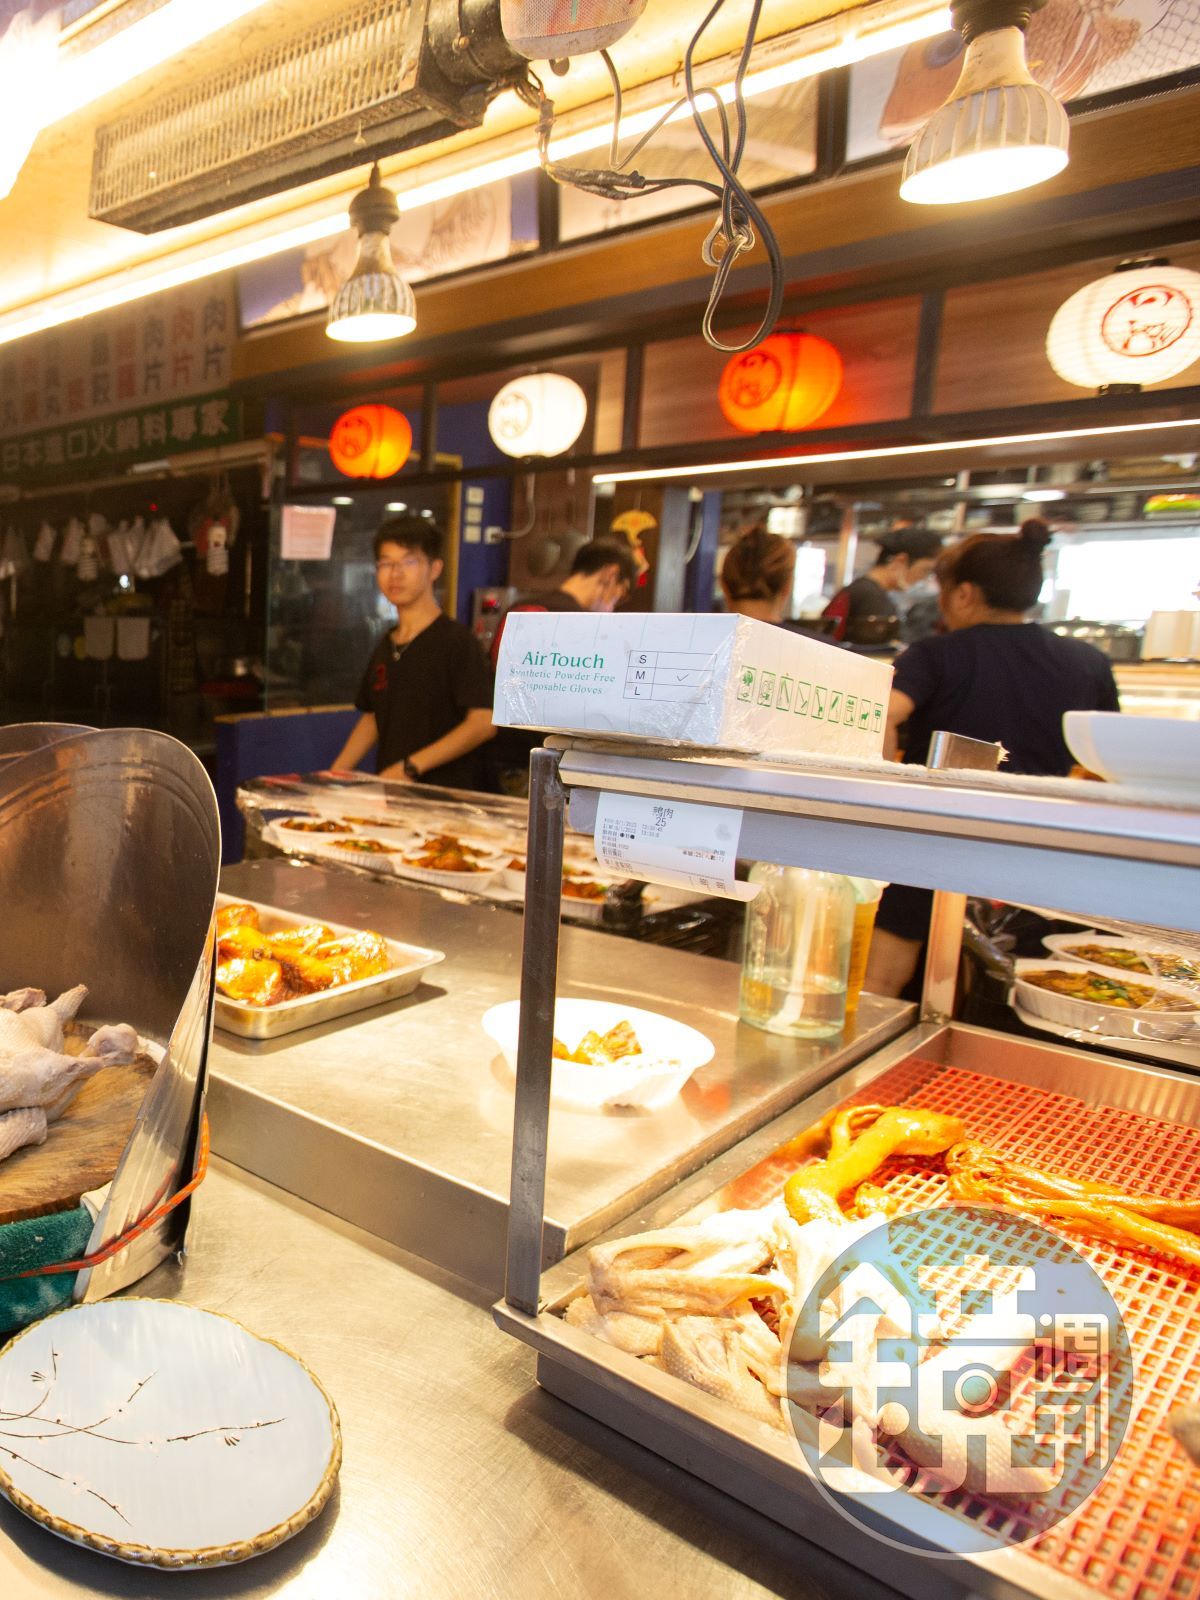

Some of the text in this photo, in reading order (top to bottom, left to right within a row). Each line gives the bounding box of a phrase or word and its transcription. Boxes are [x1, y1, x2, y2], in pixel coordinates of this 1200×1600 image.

[638, 655, 647, 664] S
[554, 670, 590, 682] Powder
[593, 672, 616, 683] Free
[635, 671, 646, 680] M
[569, 684, 603, 695] Gloves
[634, 687, 641, 696] L
[655, 816, 667, 827] 25
